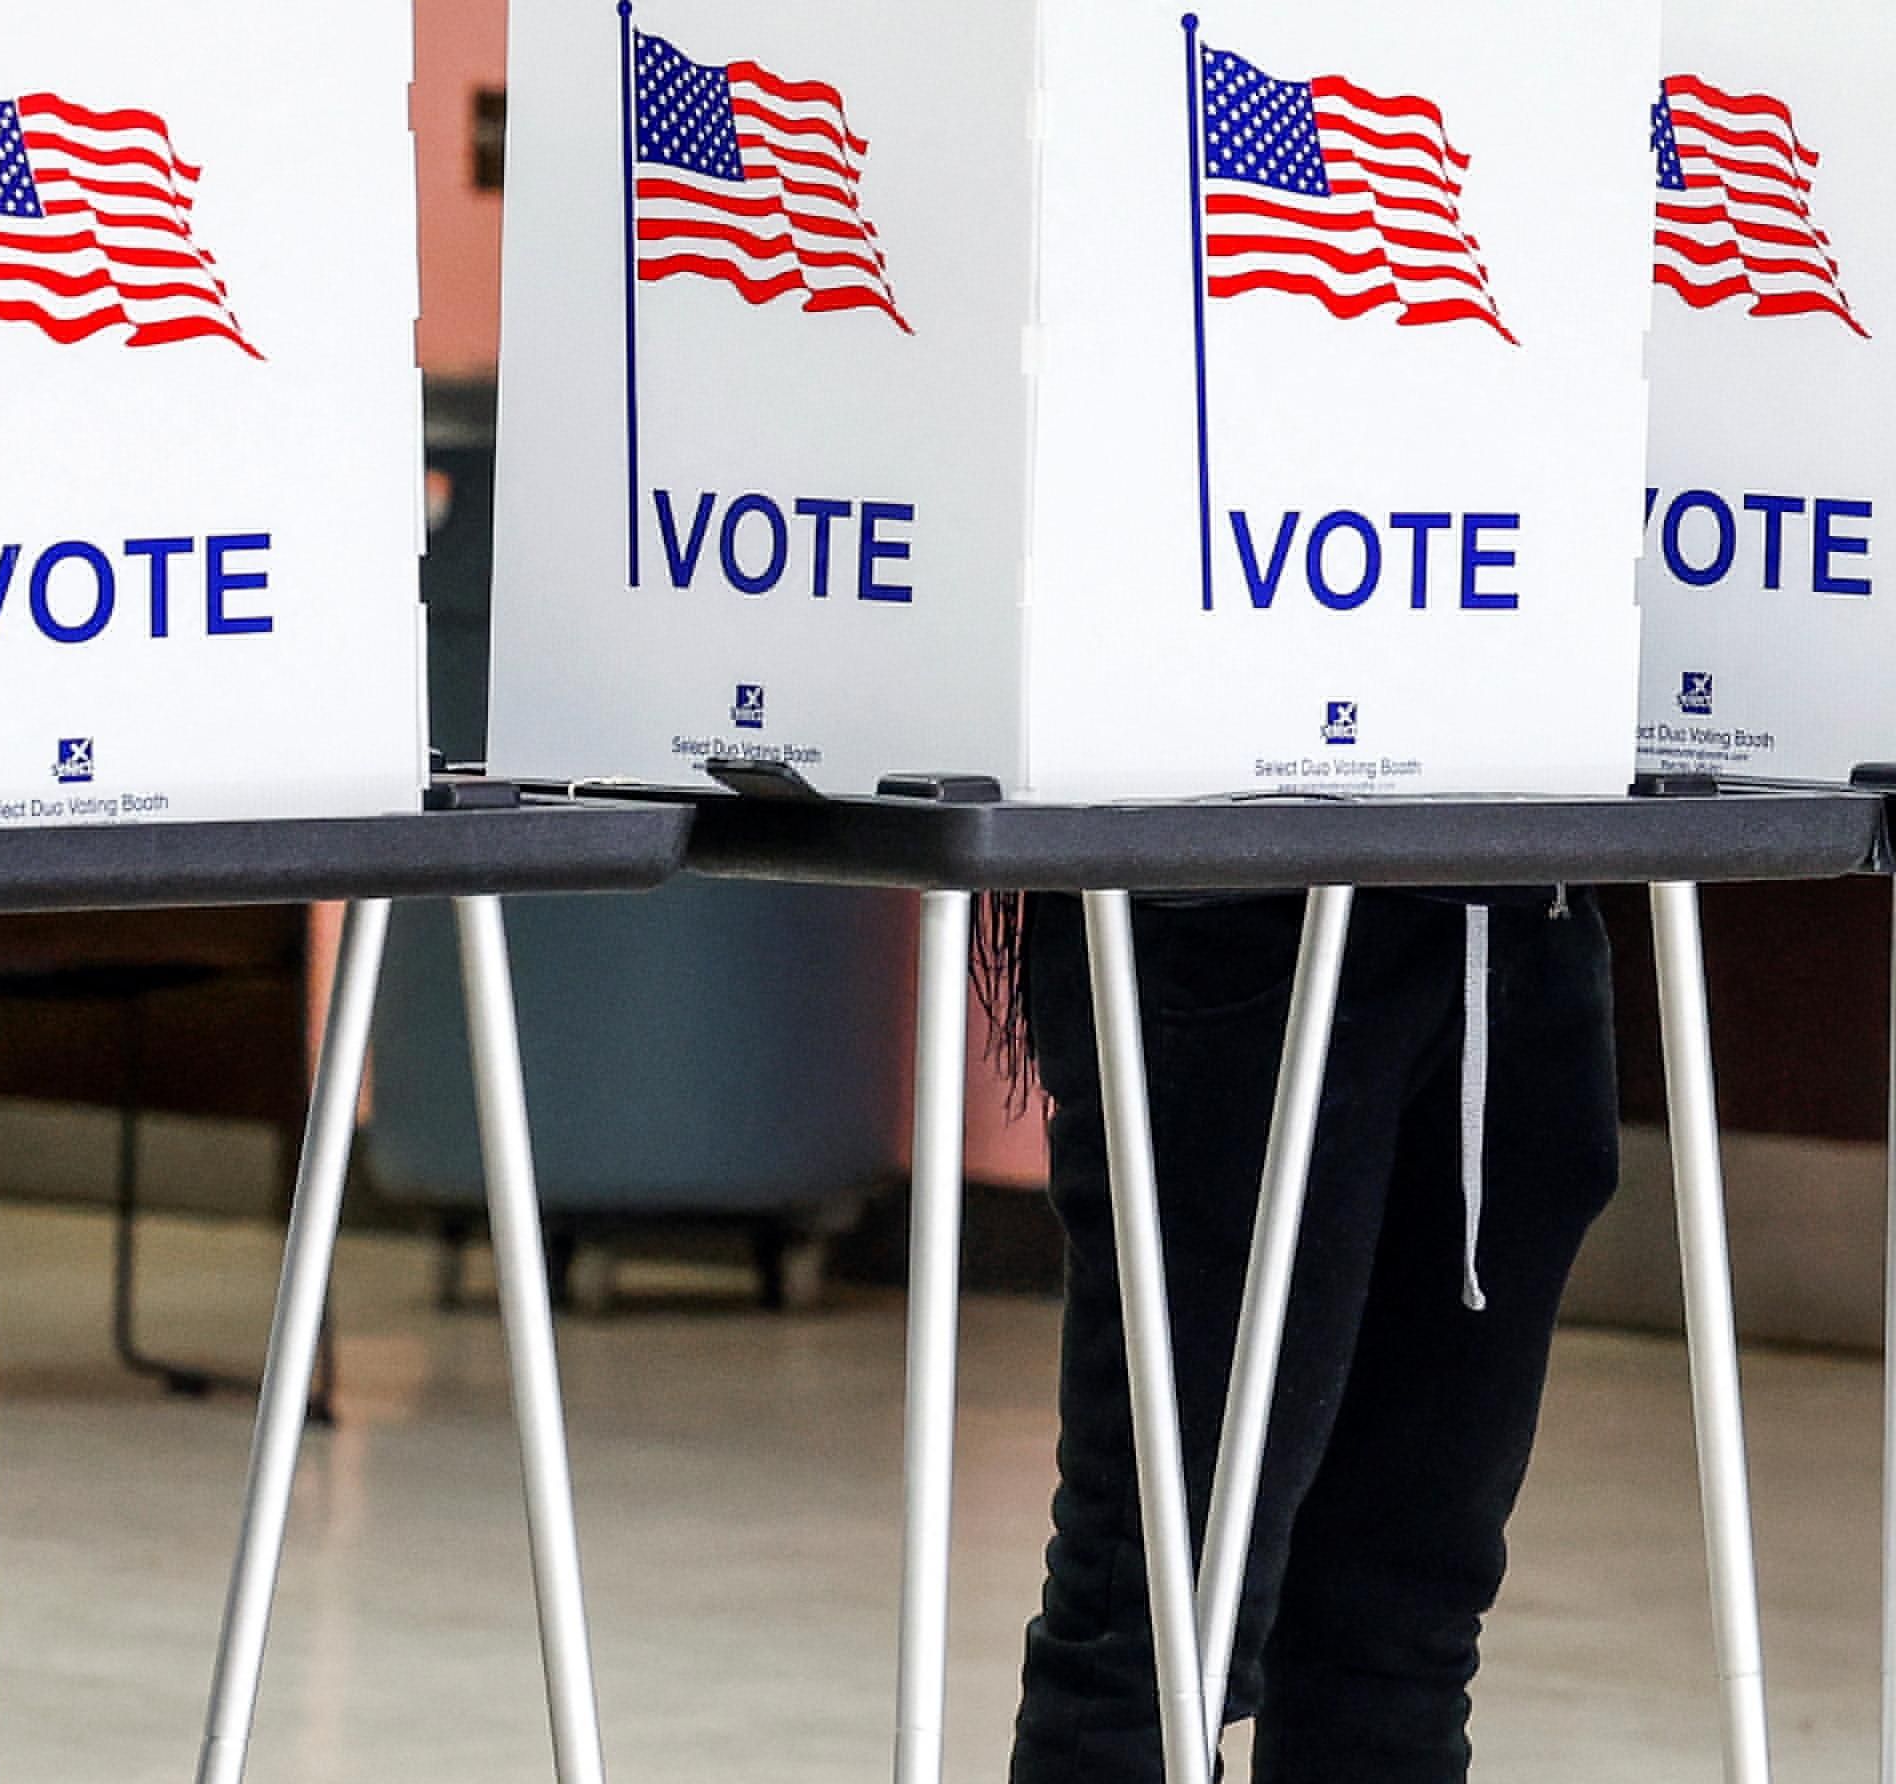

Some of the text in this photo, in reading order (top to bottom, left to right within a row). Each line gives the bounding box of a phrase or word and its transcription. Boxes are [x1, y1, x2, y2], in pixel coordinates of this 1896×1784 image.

[653, 489, 914, 602] VOTE
[1229, 510, 1520, 611] VOTE
[1658, 725, 1687, 743] Duo
[1689, 727, 1731, 750] Voting
[1735, 730, 1775, 751] Booth
[1255, 756, 1423, 780] Select Duo Voting Booth
[31, 800, 64, 817] Duo
[68, 796, 118, 817] Voting
[121, 792, 169, 811] Booth
